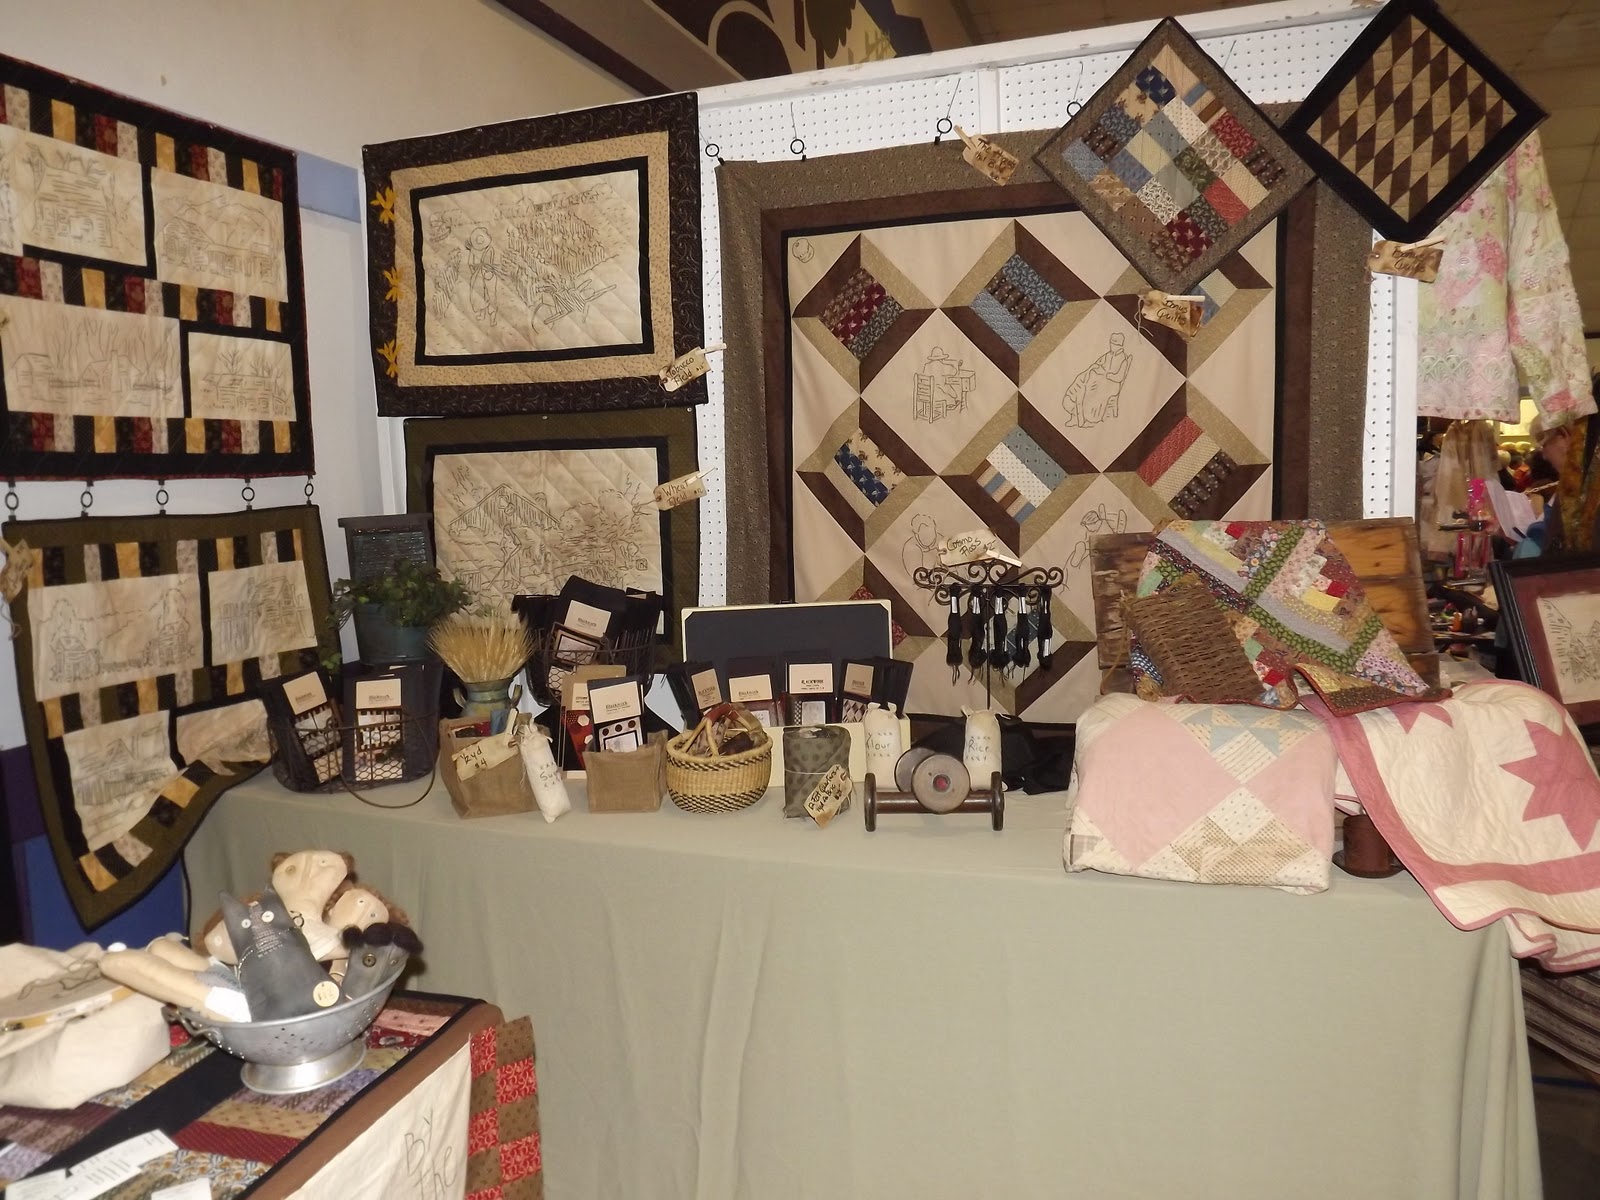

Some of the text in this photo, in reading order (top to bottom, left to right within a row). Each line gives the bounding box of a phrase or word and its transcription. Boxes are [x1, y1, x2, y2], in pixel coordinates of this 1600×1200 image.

[666, 357, 694, 378] Tobacco
[947, 536, 973, 551] Cosmo
[967, 739, 990, 752] Rice
